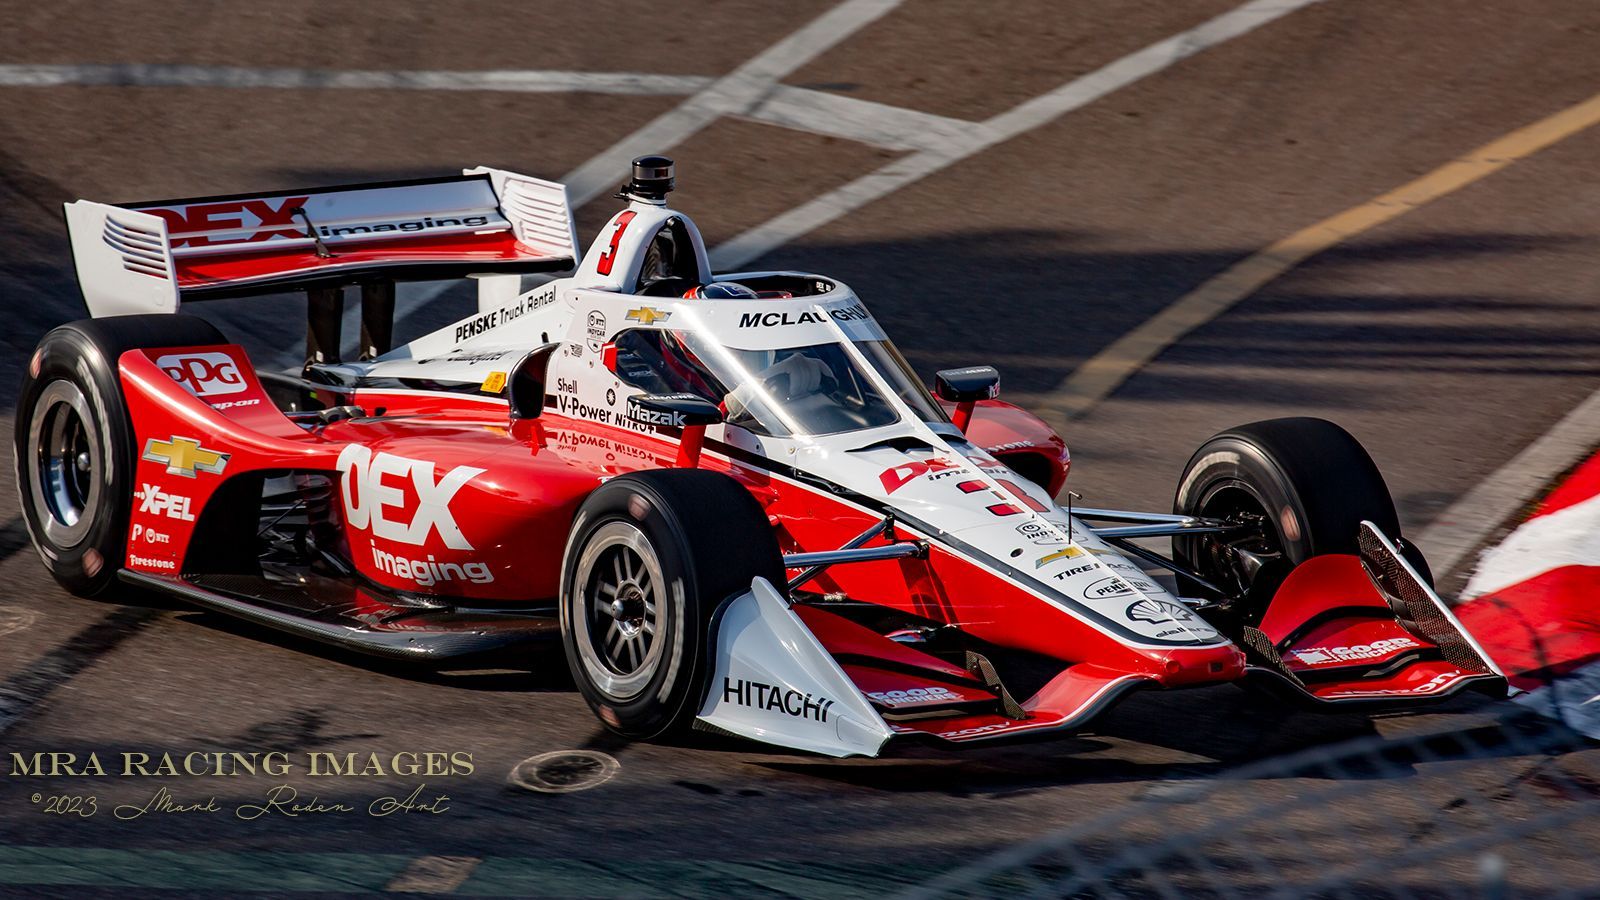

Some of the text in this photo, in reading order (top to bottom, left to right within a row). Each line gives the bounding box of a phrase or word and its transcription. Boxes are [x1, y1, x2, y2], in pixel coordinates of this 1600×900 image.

[320, 214, 489, 237] imaging
[597, 210, 638, 276] 3
[455, 285, 557, 343] PENSKE Truck Rental
[162, 358, 241, 393] PPG
[557, 377, 578, 395] Shell
[558, 394, 612, 423] V-Power
[627, 400, 688, 427] Mazak
[139, 483, 195, 521] XPEL
[335, 443, 488, 551] DEX
[129, 554, 175, 569] Firestone
[370, 538, 495, 586] imaging
[1331, 637, 1411, 655] GOOD
[723, 676, 835, 723] HITACHI
[868, 687, 949, 701] GOOD
